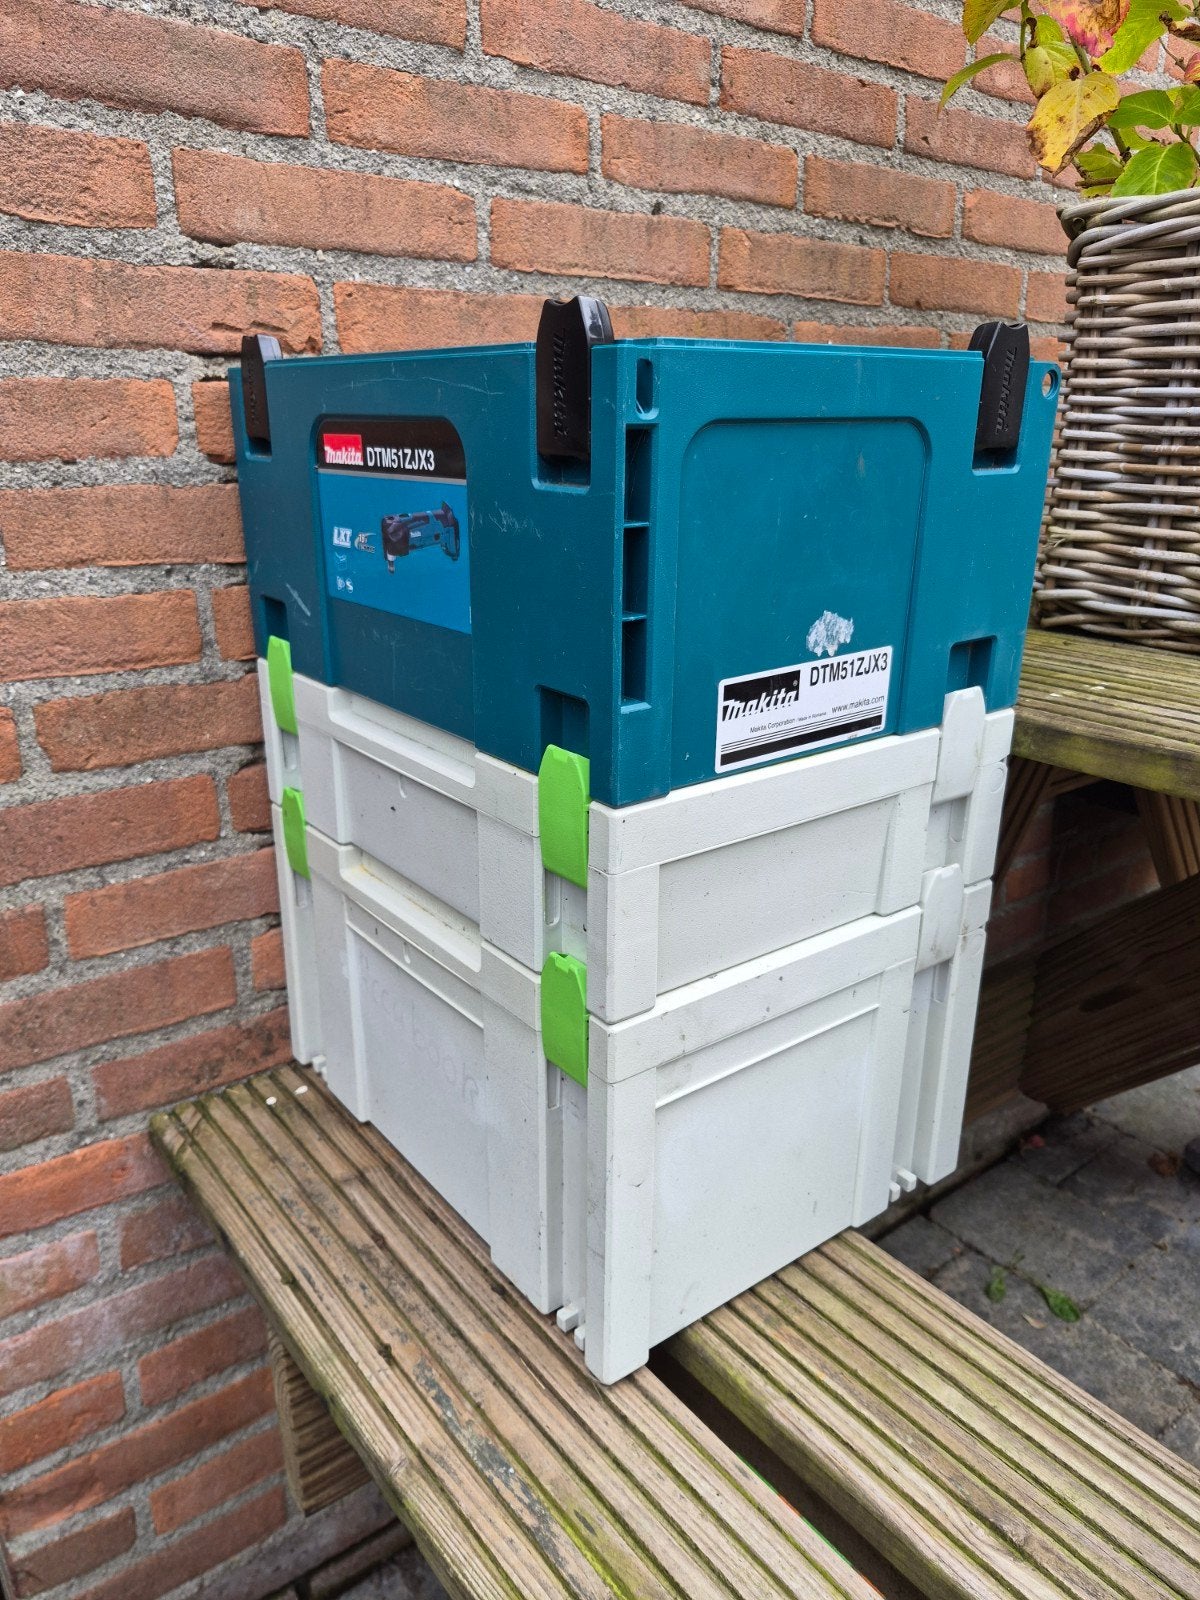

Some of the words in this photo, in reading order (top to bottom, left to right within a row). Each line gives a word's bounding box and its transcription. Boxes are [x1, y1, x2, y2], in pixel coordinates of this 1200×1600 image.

[367, 447, 435, 471] DTM51ZJX3
[333, 527, 351, 545] LXT
[809, 652, 888, 687] DTM51ZJX3
[832, 695, 885, 714] www.makita.com
[750, 723, 767, 734] Makita
[767, 718, 796, 730] Corporation
